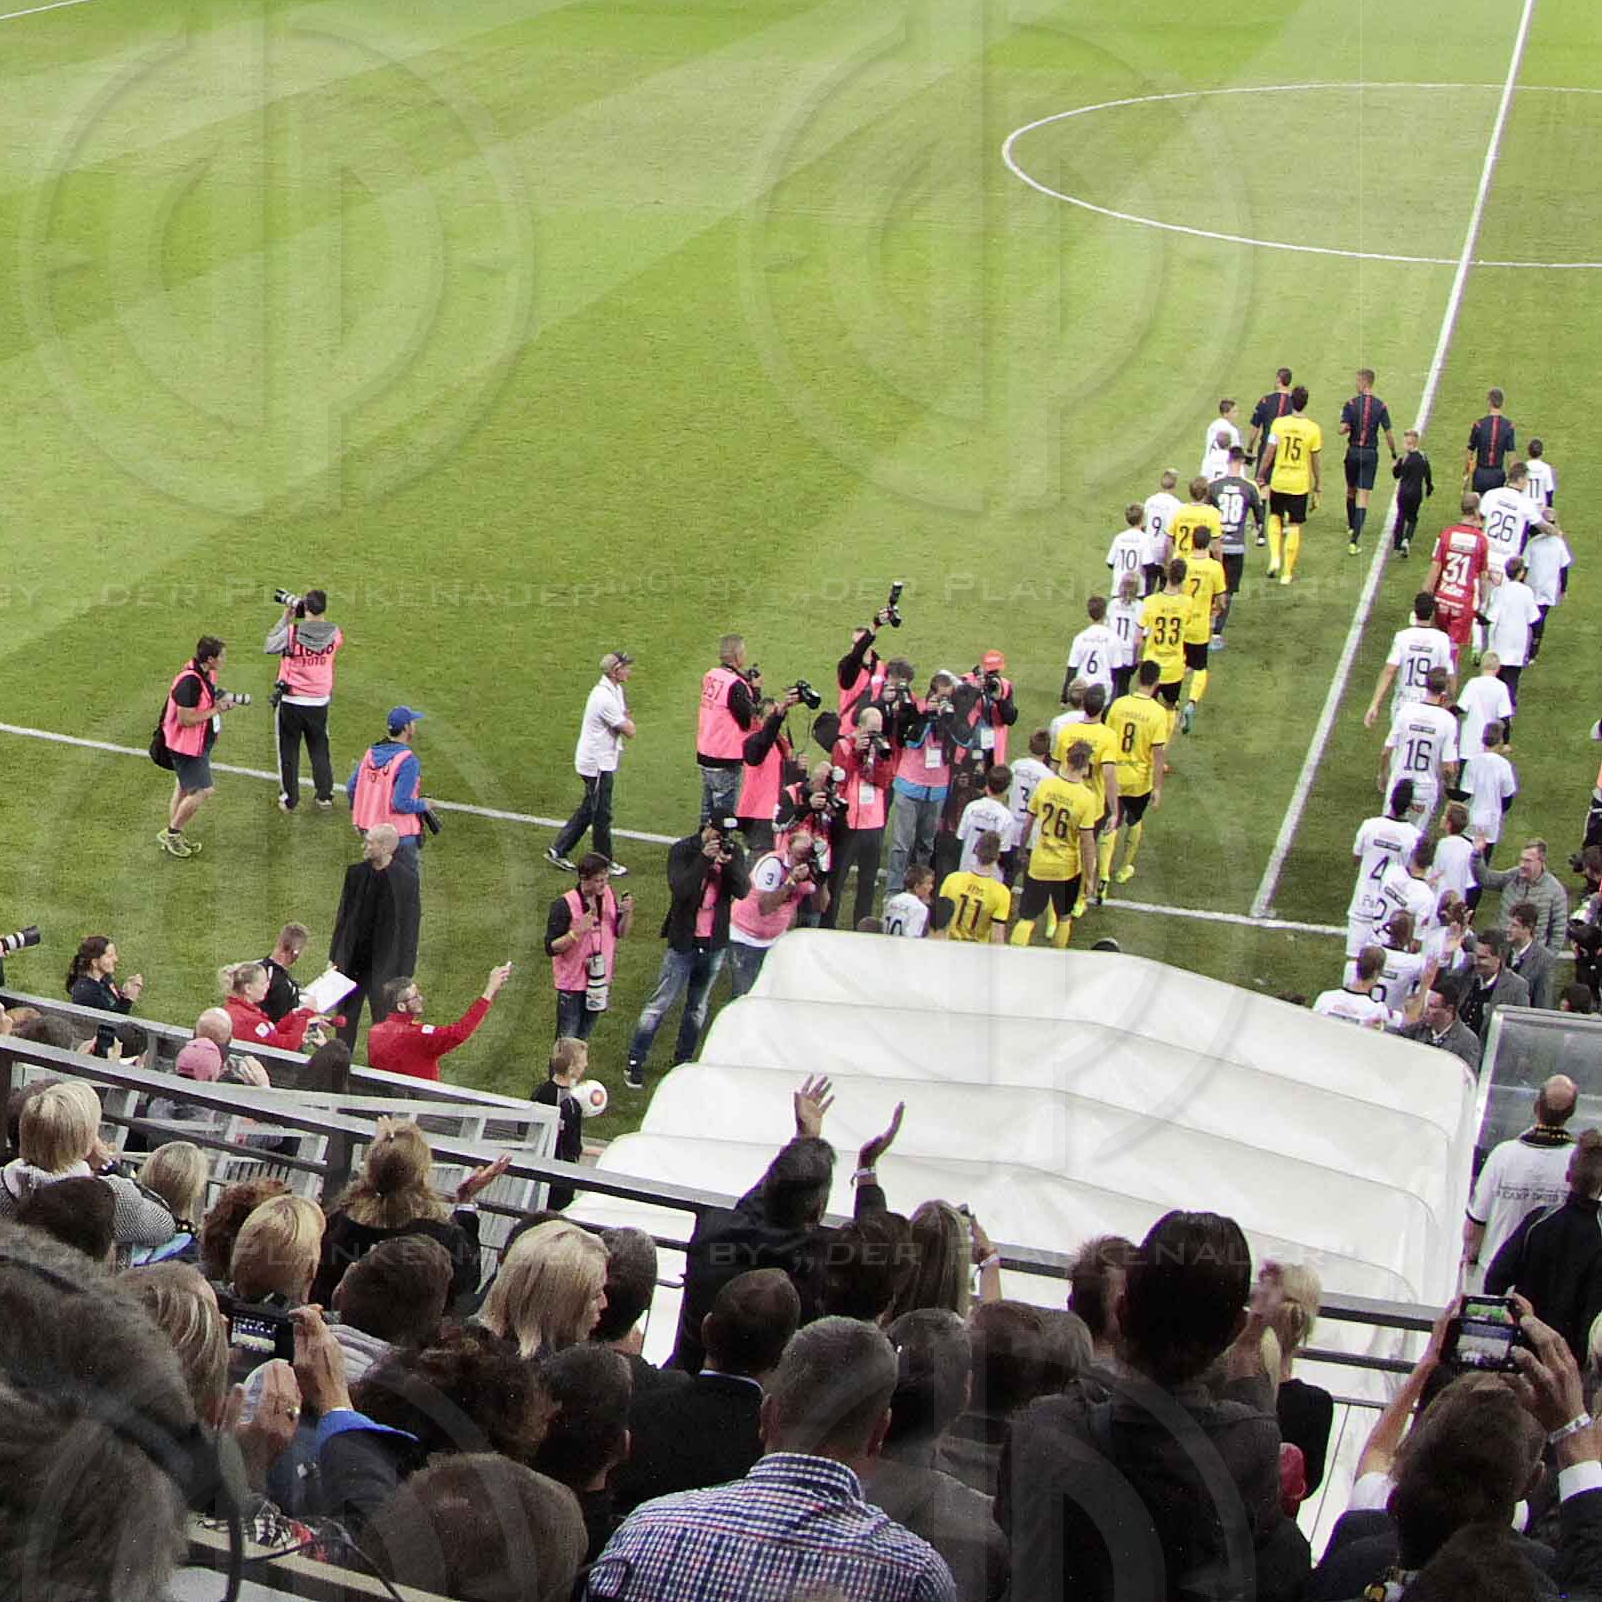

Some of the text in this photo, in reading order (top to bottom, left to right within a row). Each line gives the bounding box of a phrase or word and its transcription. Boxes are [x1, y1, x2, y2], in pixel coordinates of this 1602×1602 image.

[1284, 436, 1303, 461] 15
[1151, 516, 1163, 537] 9
[1487, 510, 1517, 543] 26
[1119, 548, 1137, 572] 10
[1442, 550, 1472, 586] 31
[1116, 617, 1130, 641] 11
[1153, 616, 1181, 646] 33
[1087, 651, 1098, 675] 6
[1405, 657, 1431, 688] 19
[1121, 721, 1136, 754] 8
[1403, 739, 1433, 772] 16
[1041, 802, 1070, 839] 26
[957, 894, 982, 931] 11
